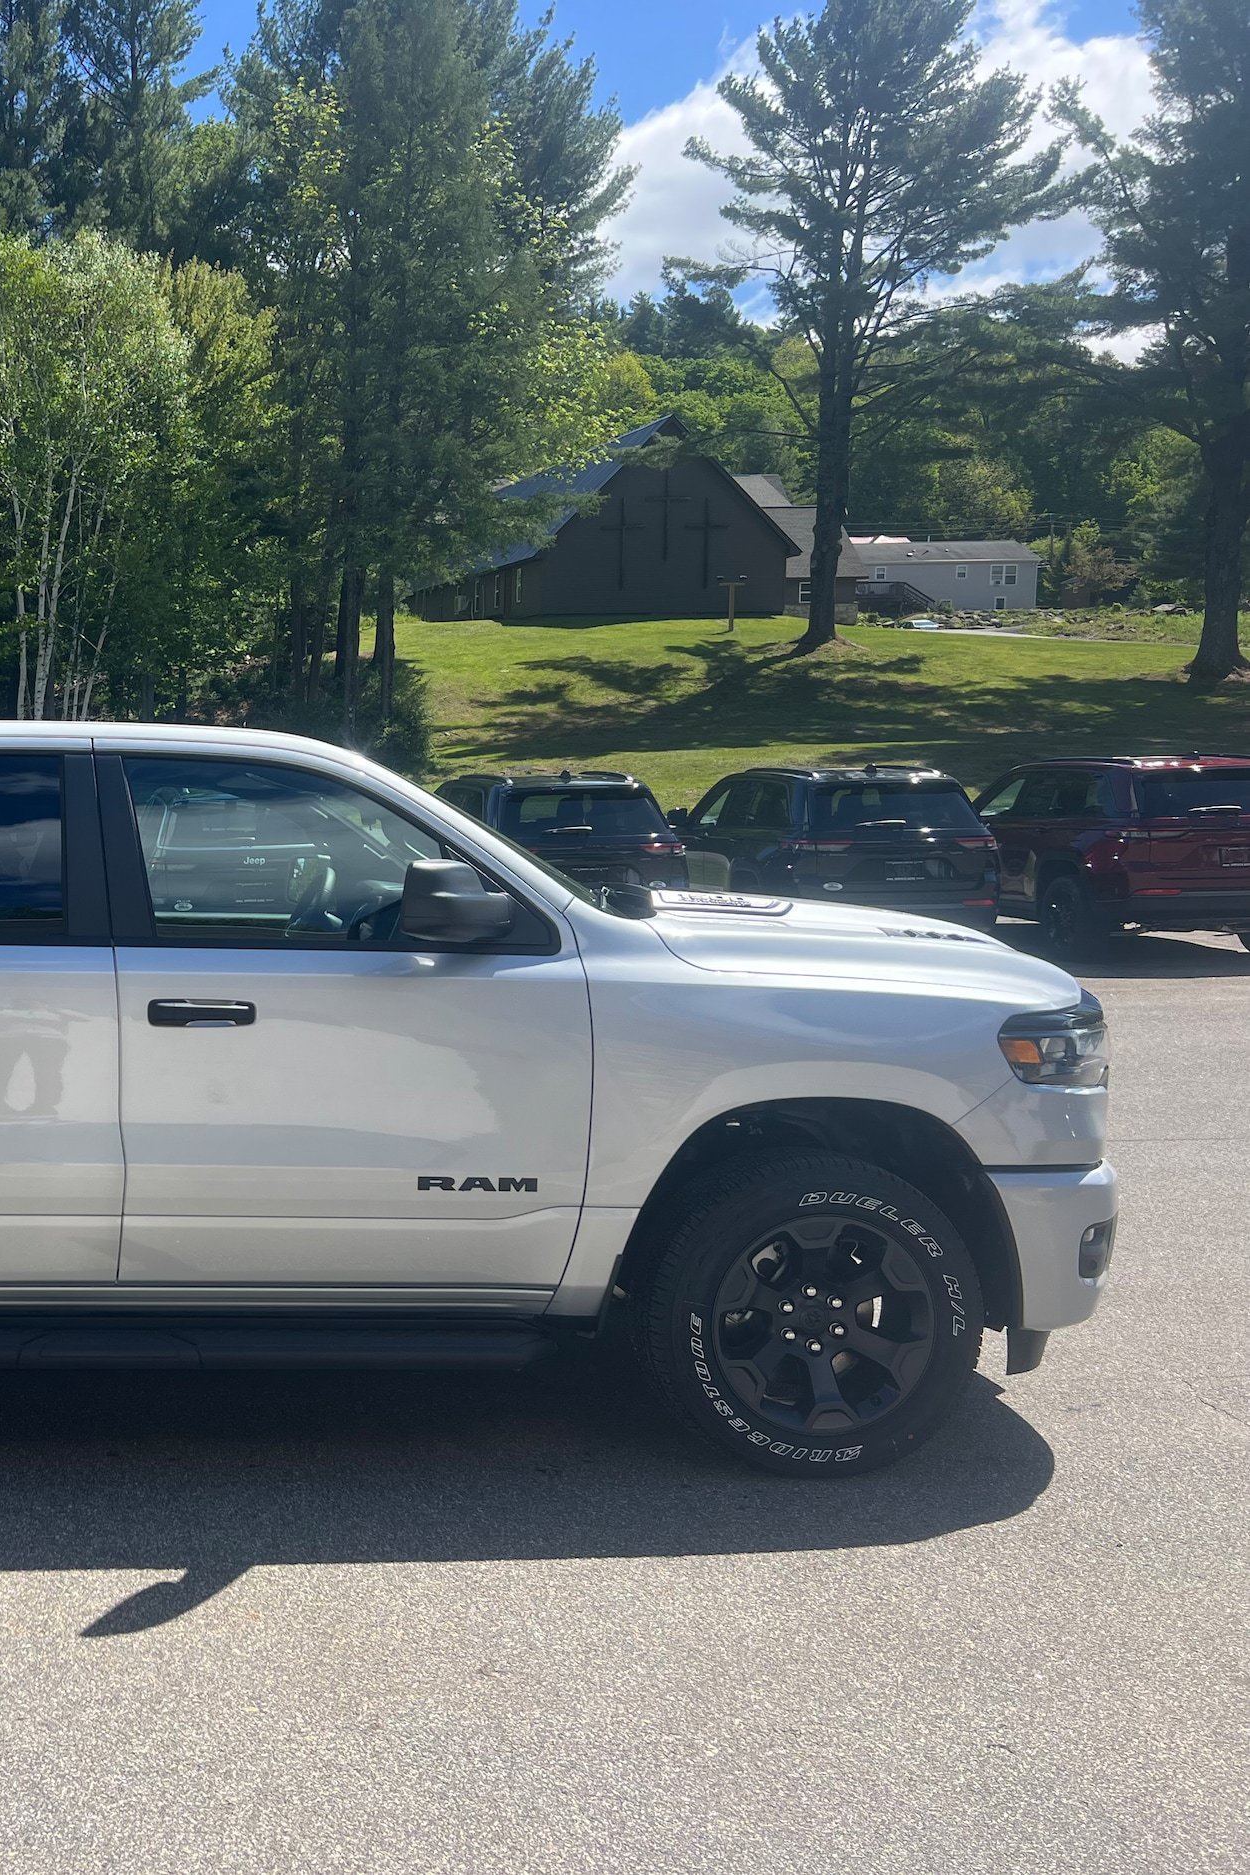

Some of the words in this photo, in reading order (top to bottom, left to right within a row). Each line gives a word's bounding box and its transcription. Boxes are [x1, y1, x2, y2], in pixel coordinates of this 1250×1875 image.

[243, 856, 265, 866] Jeep
[417, 1176, 538, 1192] RAM
[799, 1191, 943, 1258] DUELER
[942, 1274, 966, 1336] H/L
[690, 1312, 863, 1462] BRIDGESTONE
